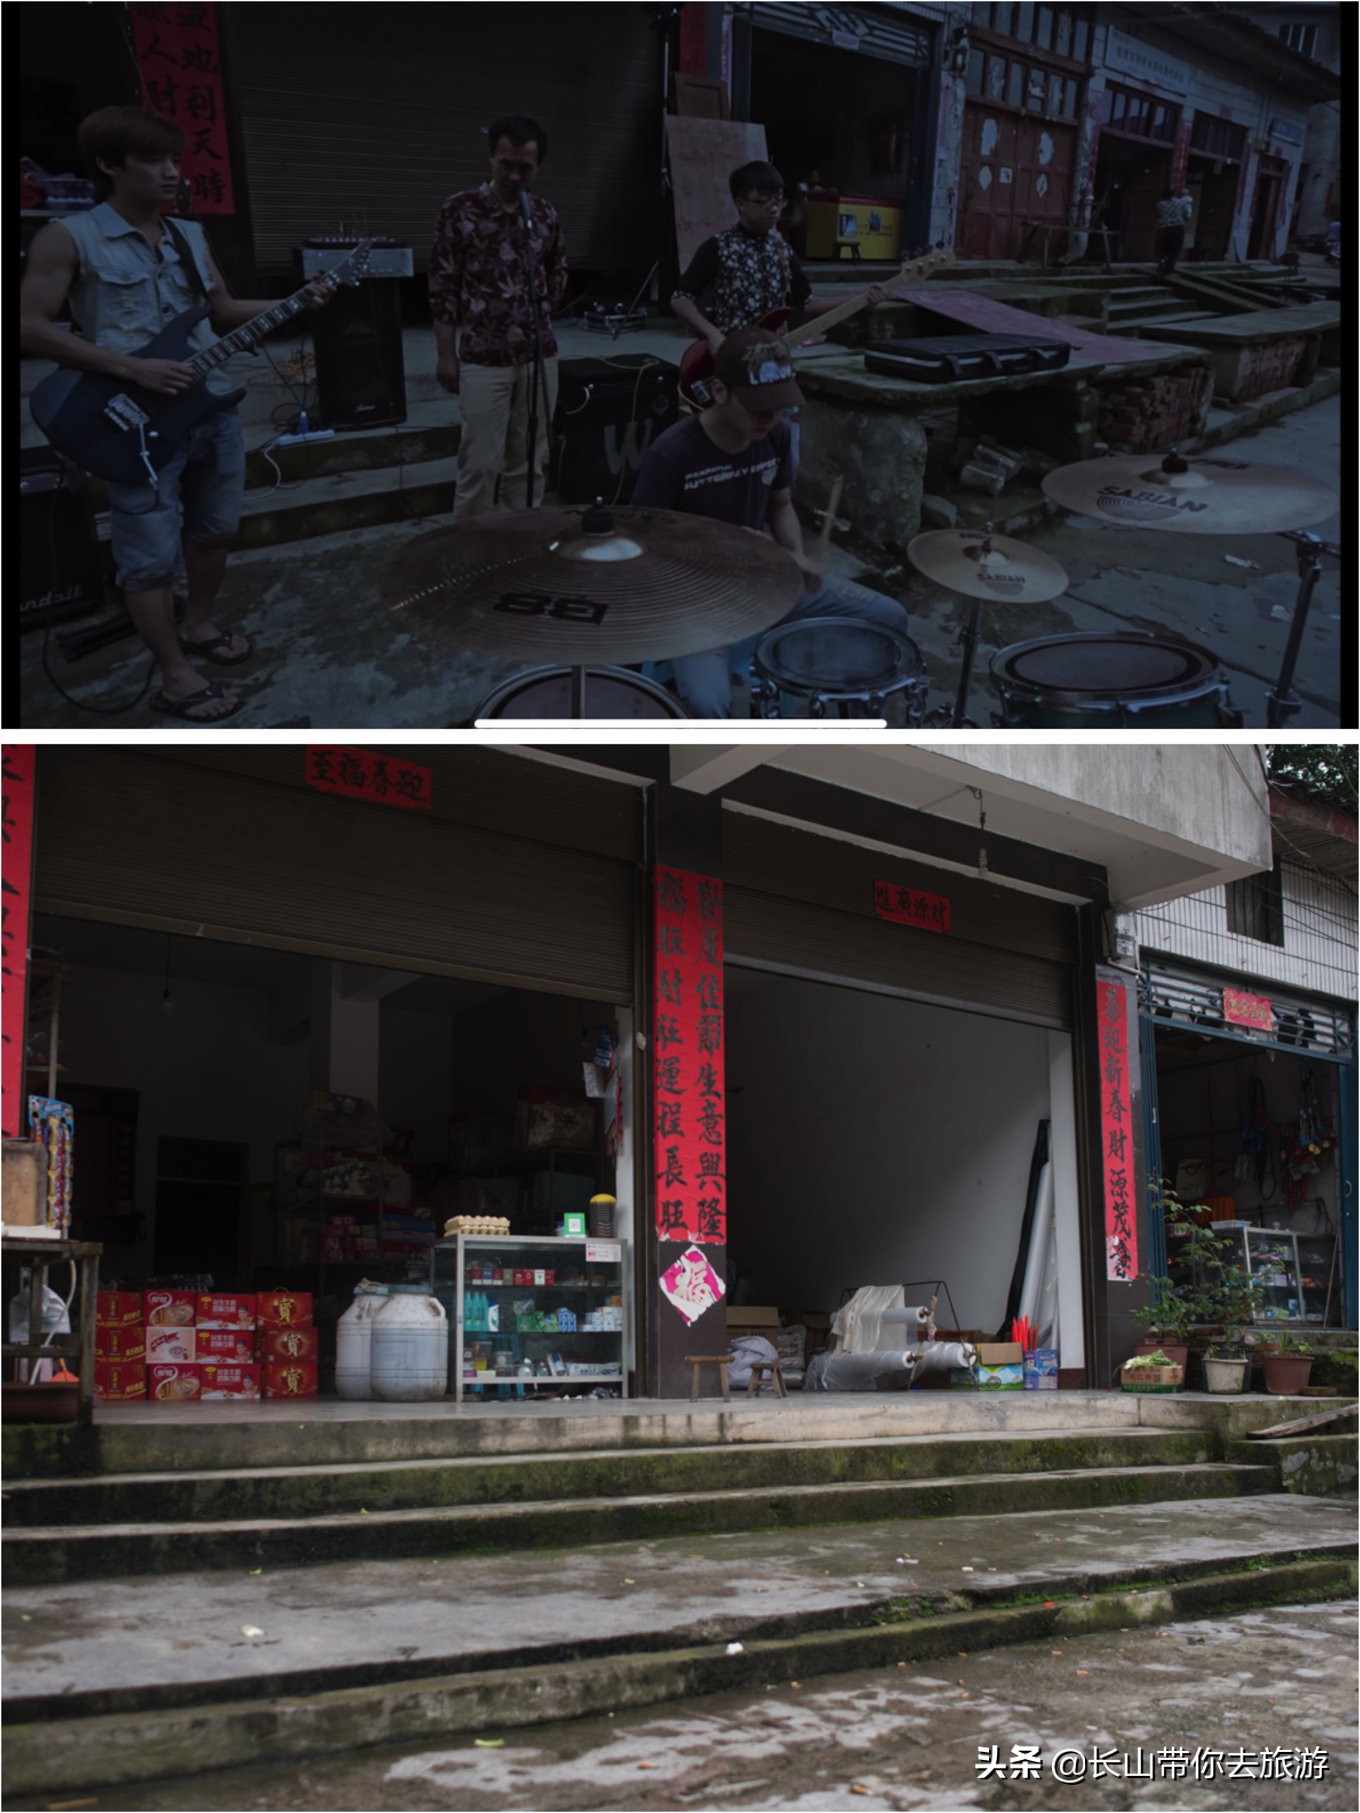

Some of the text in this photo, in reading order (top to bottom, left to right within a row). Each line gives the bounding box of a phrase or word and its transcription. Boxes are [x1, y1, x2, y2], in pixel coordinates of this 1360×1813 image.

[1096, 484, 1208, 513] SABIAN
[976, 571, 1026, 585] SABIAN
[20, 583, 81, 613] ndall
